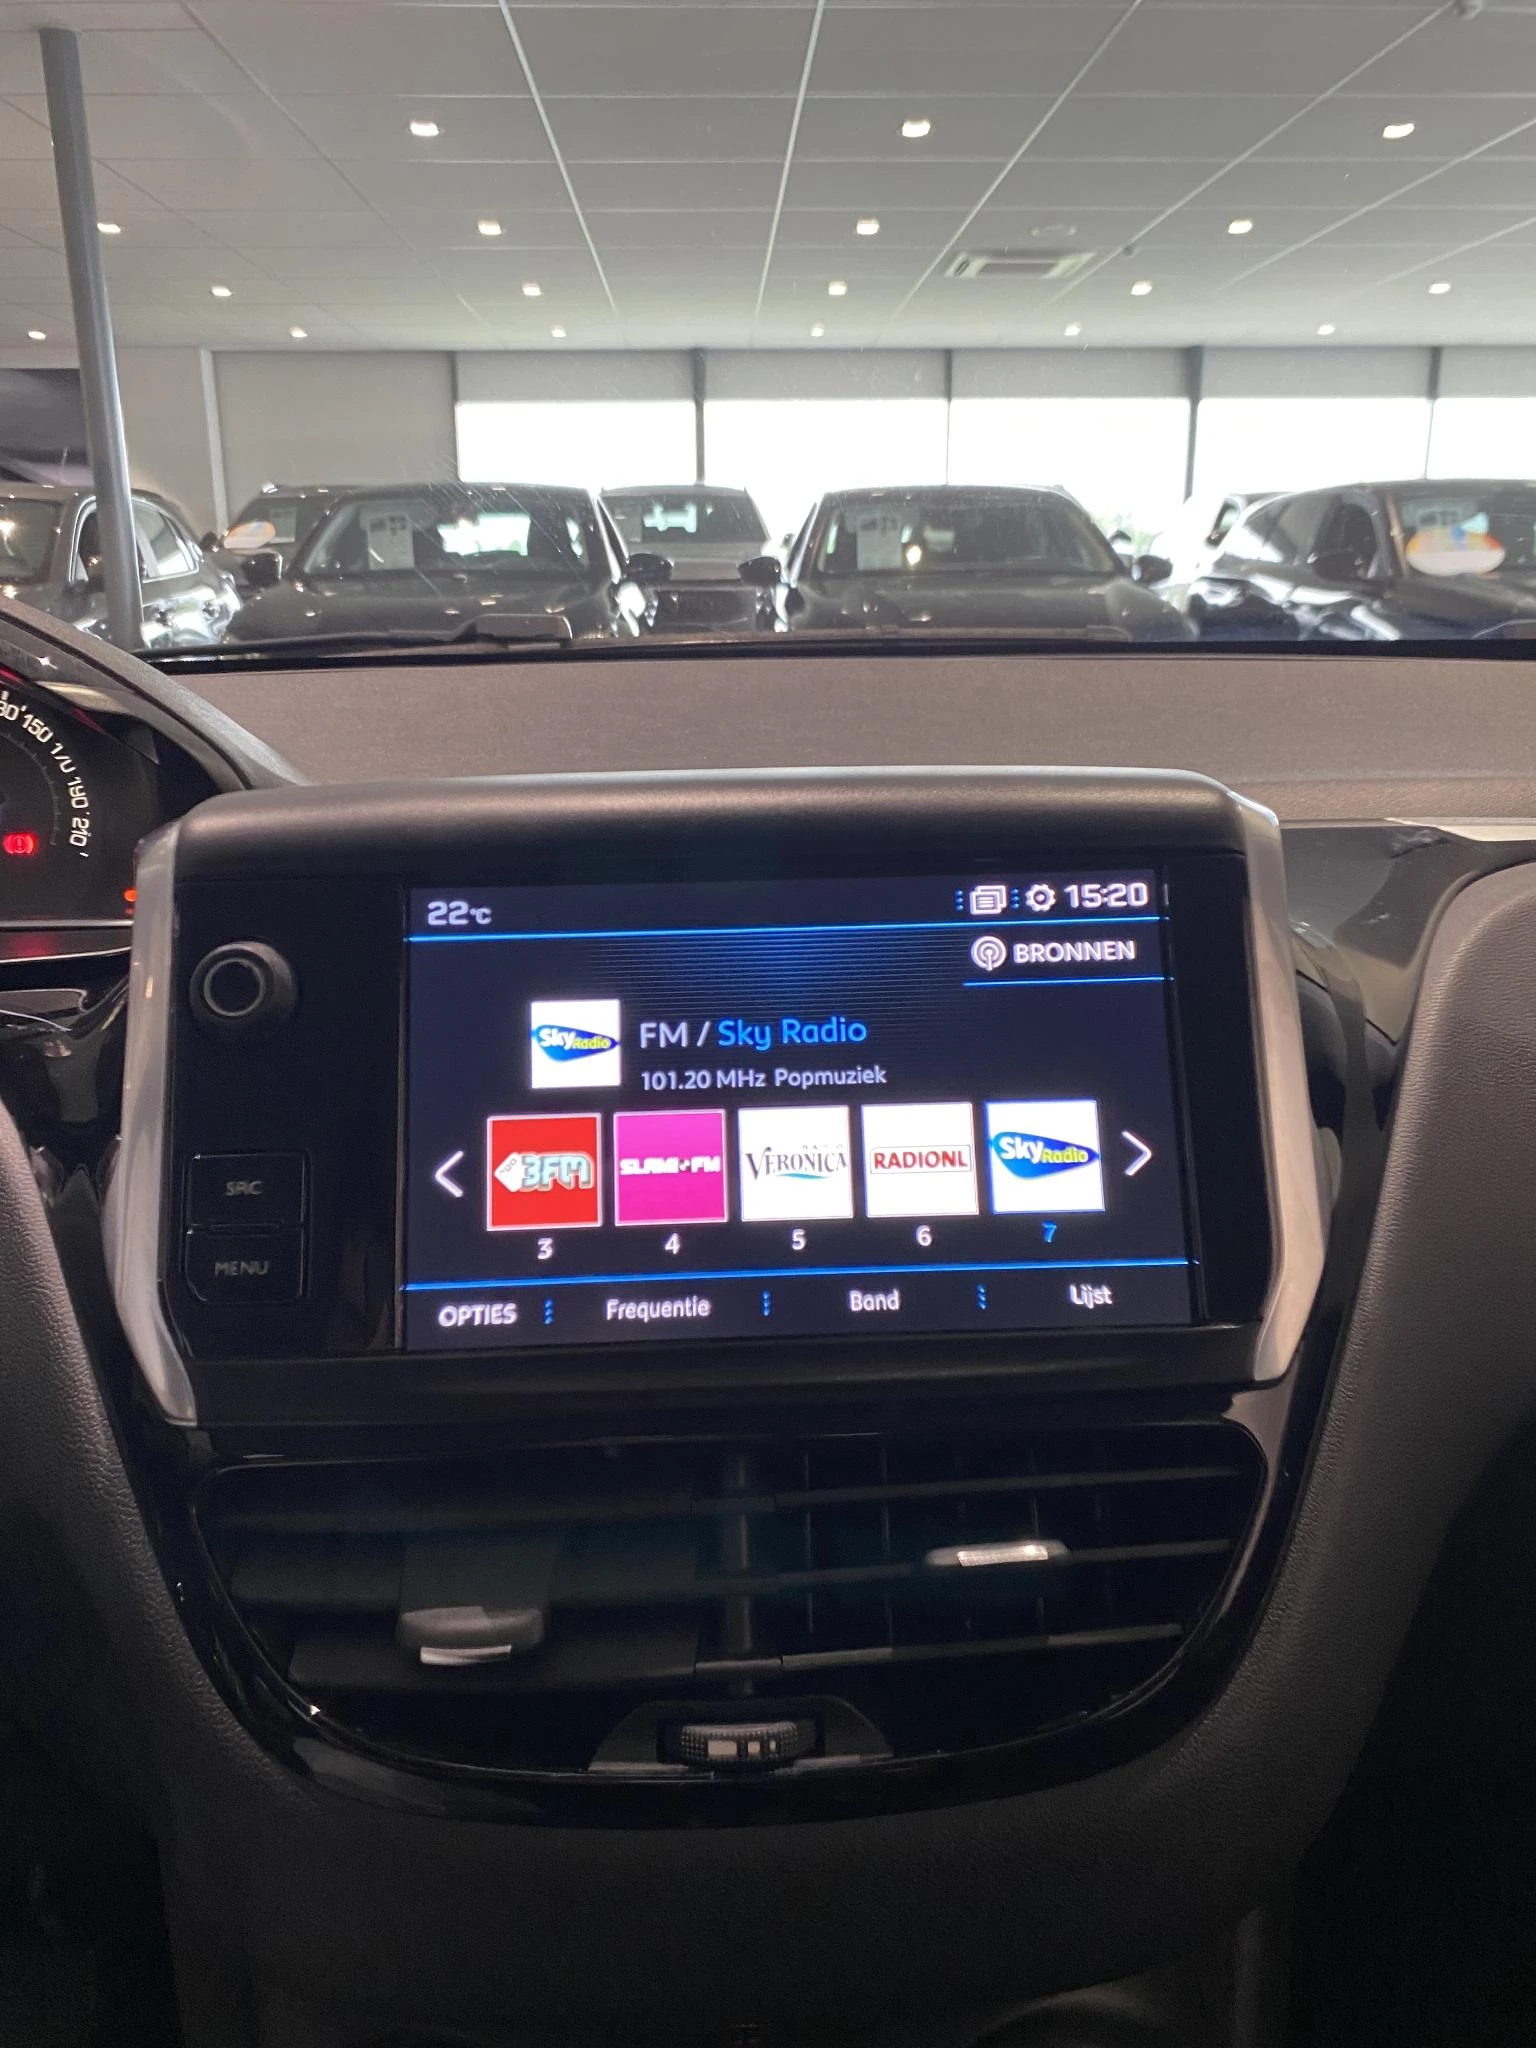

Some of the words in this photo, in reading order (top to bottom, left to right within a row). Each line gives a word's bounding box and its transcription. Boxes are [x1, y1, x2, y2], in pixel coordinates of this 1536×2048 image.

[21, 713, 54, 743] 150
[69, 816, 90, 847] 210
[1063, 882, 1149, 909] 15:20
[1012, 940, 1136, 964] BRONNEN
[538, 1027, 575, 1050] Sky
[572, 1034, 612, 1050] Radio
[639, 1021, 688, 1049] FM
[697, 1020, 711, 1047] /
[718, 1017, 771, 1051] Sky
[782, 1016, 868, 1044] Radio
[641, 1070, 711, 1091] 101.20
[716, 1068, 766, 1089] MHz
[774, 1064, 888, 1090] Popmuziek
[873, 1150, 968, 1170] RADIONL
[999, 1136, 1044, 1164] Sky
[1042, 1147, 1089, 1165] Radio
[521, 1154, 594, 1190] 3FM
[225, 1180, 263, 1196] SRC
[664, 1233, 681, 1254] 4
[791, 1229, 808, 1250] 5
[915, 1225, 932, 1247] 6
[1041, 1221, 1058, 1243] 7
[537, 1238, 554, 1260] 3
[214, 1260, 270, 1278] MENU
[849, 1290, 900, 1312] Band
[1069, 1284, 1113, 1309] Lijst
[437, 1303, 518, 1328] OPTIES
[606, 1295, 712, 1323] Frequentie
